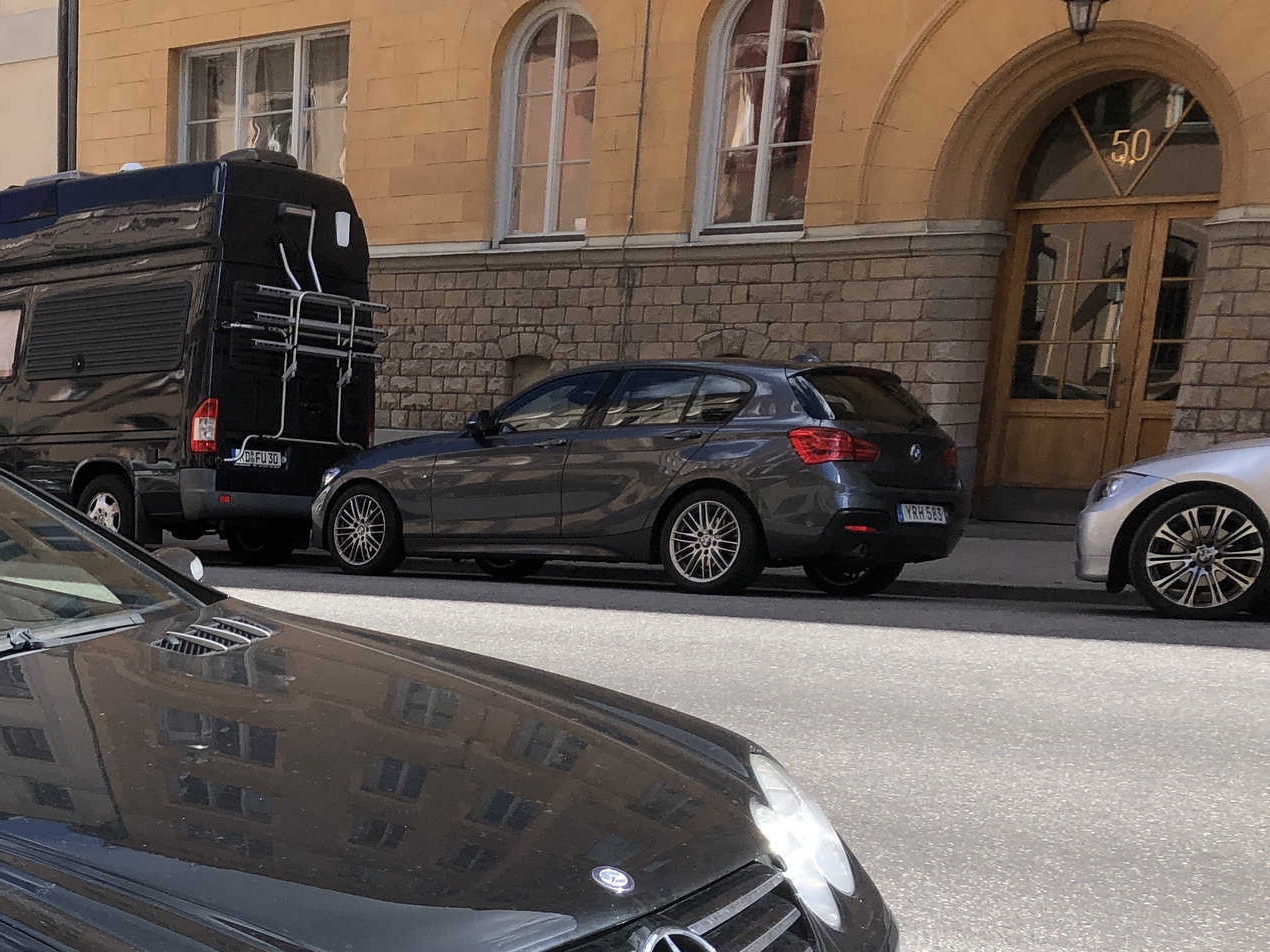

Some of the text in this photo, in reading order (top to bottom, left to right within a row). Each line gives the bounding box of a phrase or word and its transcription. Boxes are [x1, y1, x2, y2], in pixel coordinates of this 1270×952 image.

[1111, 128, 1151, 163] 50
[255, 452, 267, 464] FU
[268, 453, 279, 465] 30
[905, 505, 943, 521] YRH 583
